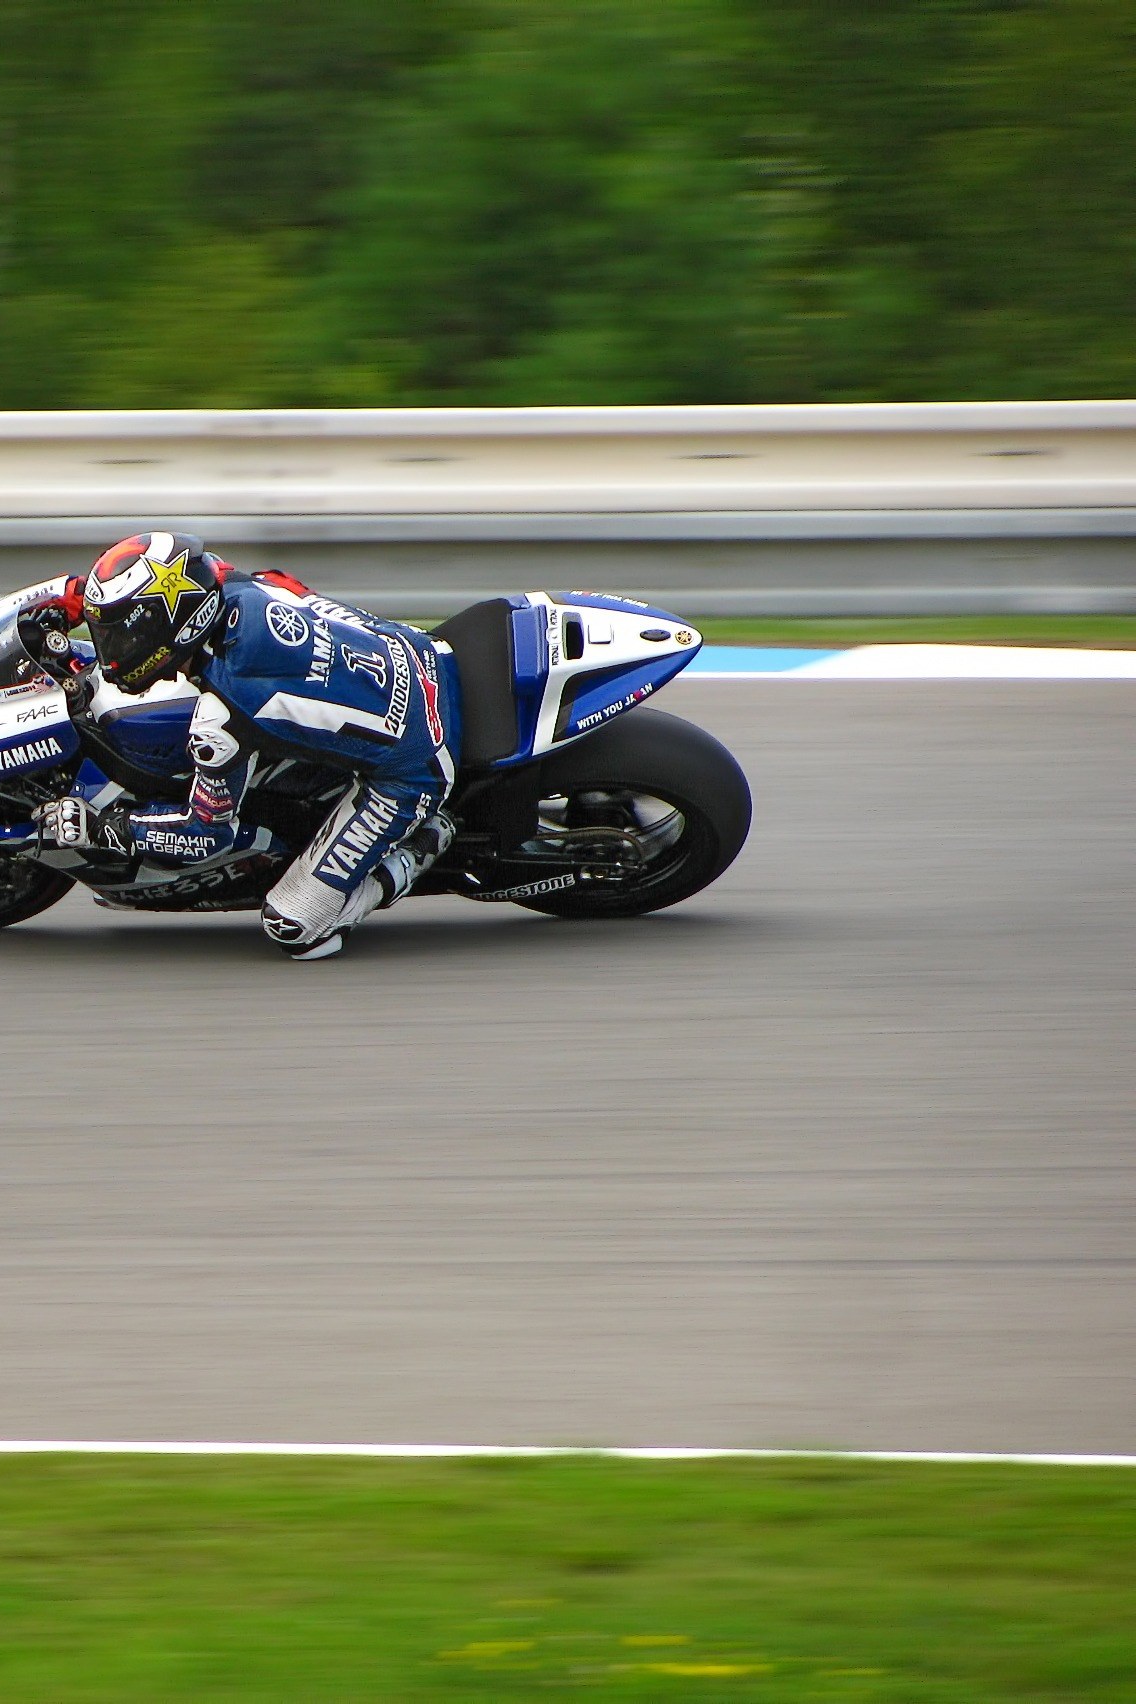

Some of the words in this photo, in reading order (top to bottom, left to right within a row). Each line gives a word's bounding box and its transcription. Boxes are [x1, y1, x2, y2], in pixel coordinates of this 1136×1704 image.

[16, 704, 59, 723] FAAC
[577, 713, 603, 730] WITH
[603, 701, 623, 718] YOU
[135, 840, 150, 852] DI
[473, 873, 576, 900] DGESTONE
